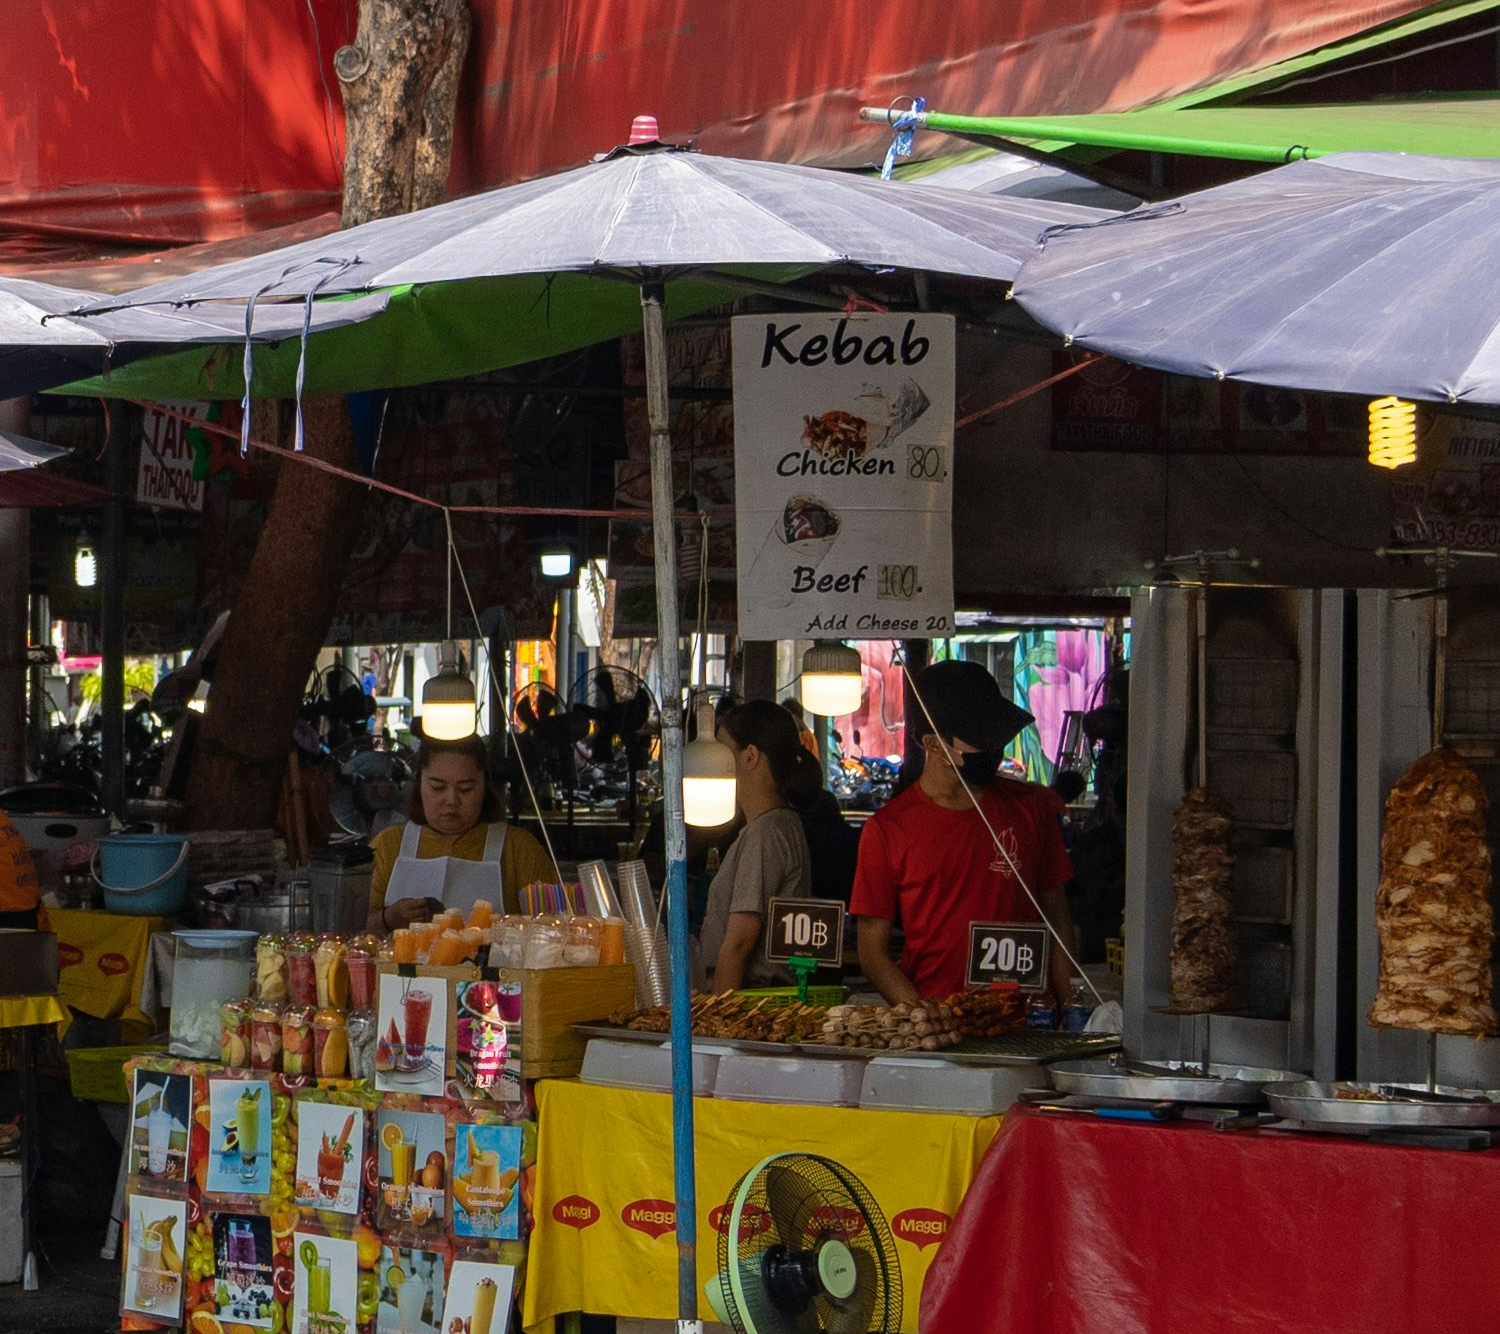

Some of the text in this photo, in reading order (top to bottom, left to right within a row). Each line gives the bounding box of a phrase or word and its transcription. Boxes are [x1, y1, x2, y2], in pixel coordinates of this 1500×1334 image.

[761, 319, 930, 369] Kebab
[152, 405, 196, 460] TAK
[777, 449, 895, 478] Chicken
[792, 565, 868, 595] Beef
[807, 613, 952, 633] Add Cheese 20.
[900, 1218, 947, 1236] Maggi
